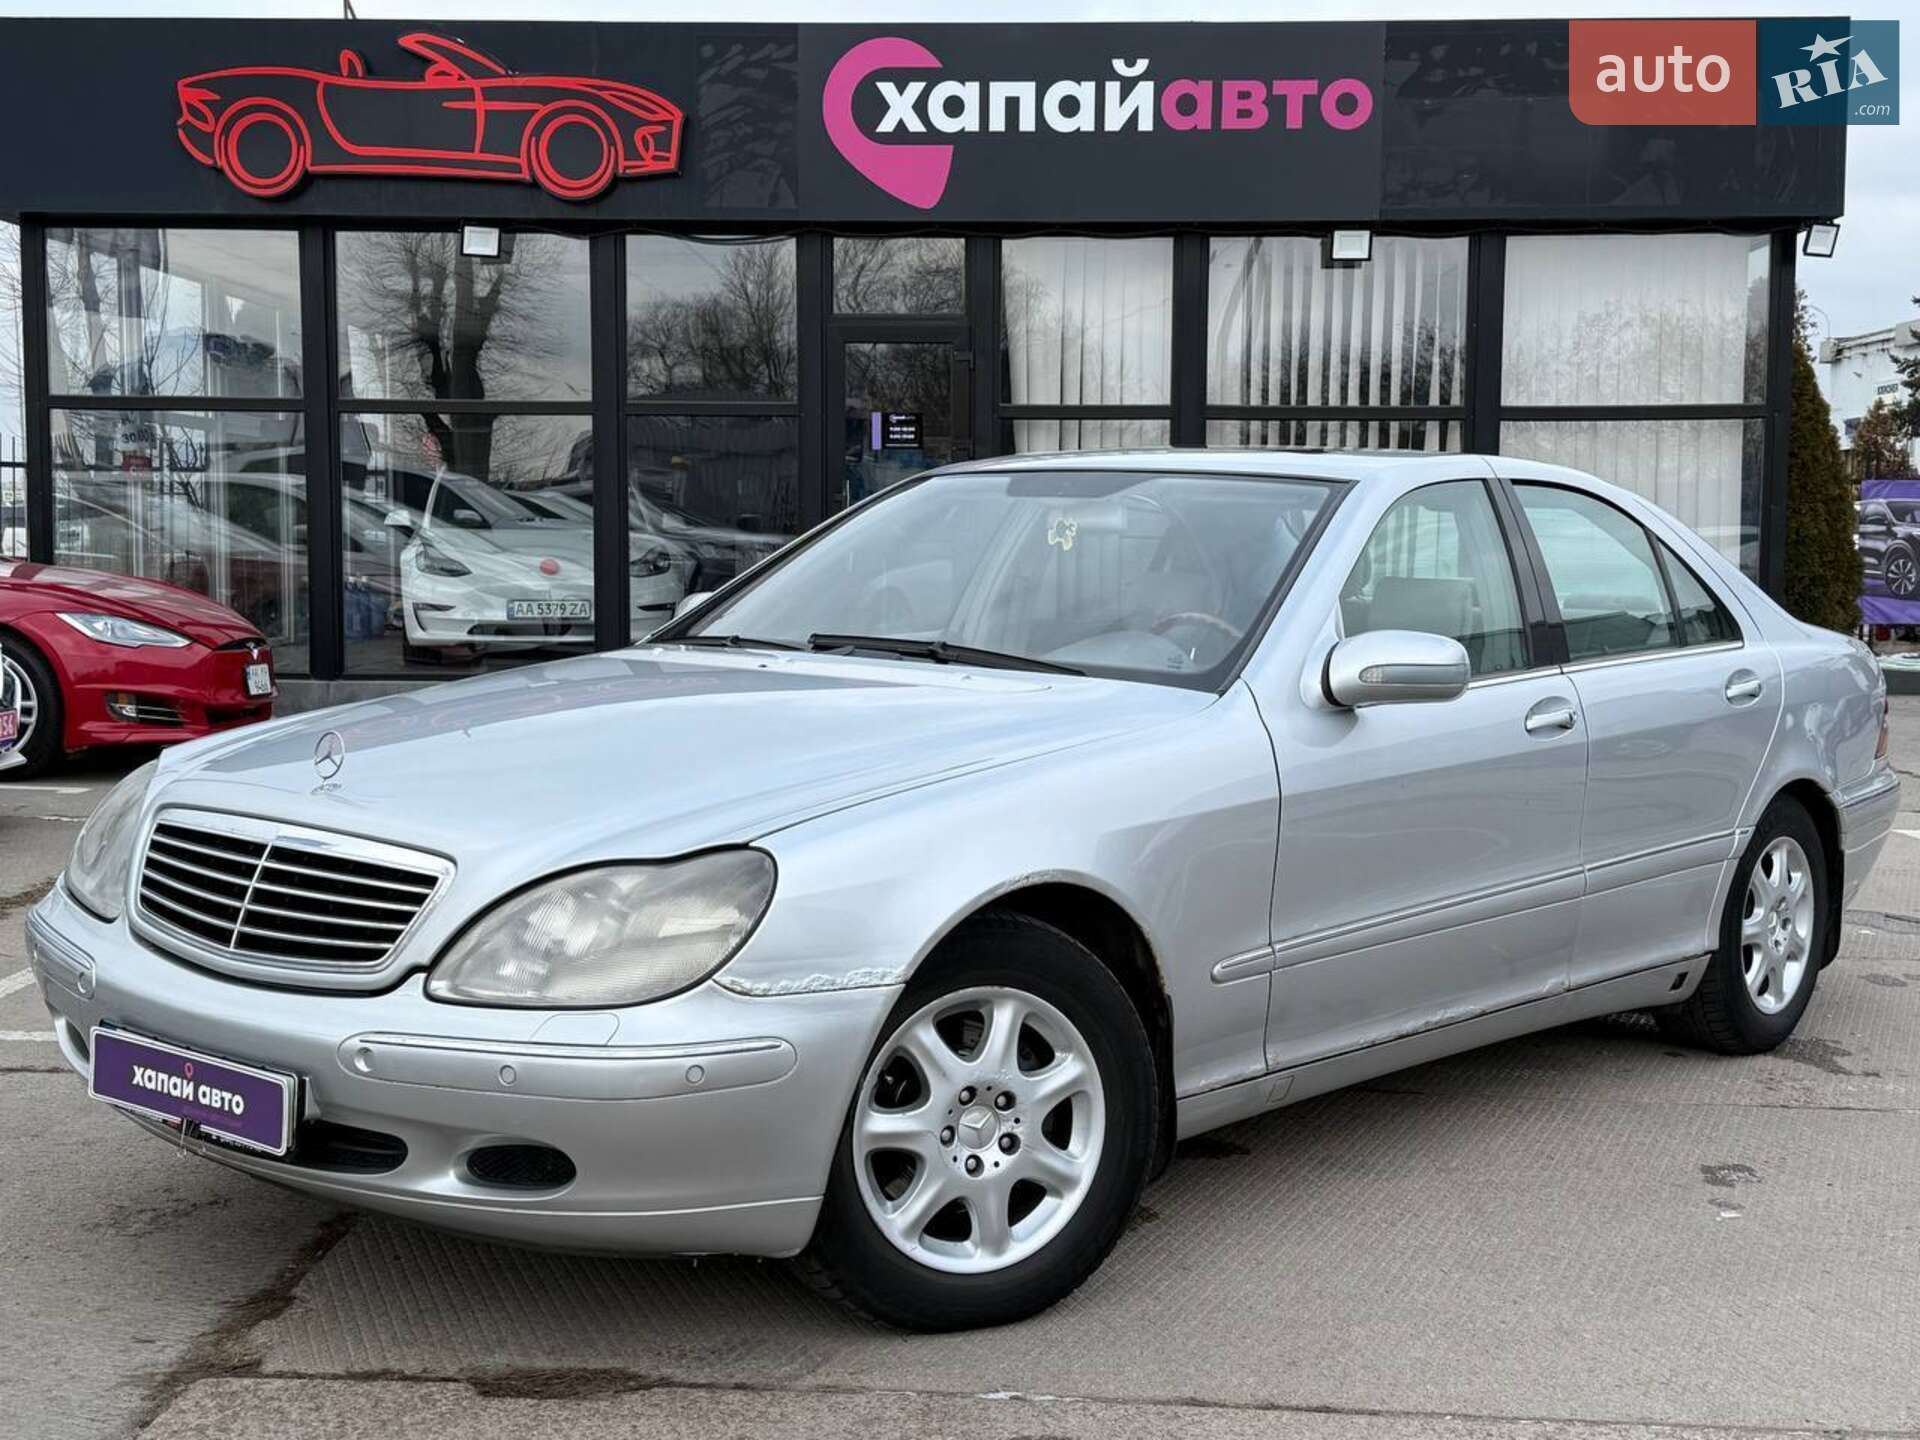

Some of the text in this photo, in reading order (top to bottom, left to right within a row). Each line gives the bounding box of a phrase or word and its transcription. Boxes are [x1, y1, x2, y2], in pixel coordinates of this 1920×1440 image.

[516, 603, 534, 616] AA
[569, 602, 588, 616] ZA
[198, 1084, 244, 1115] авто
